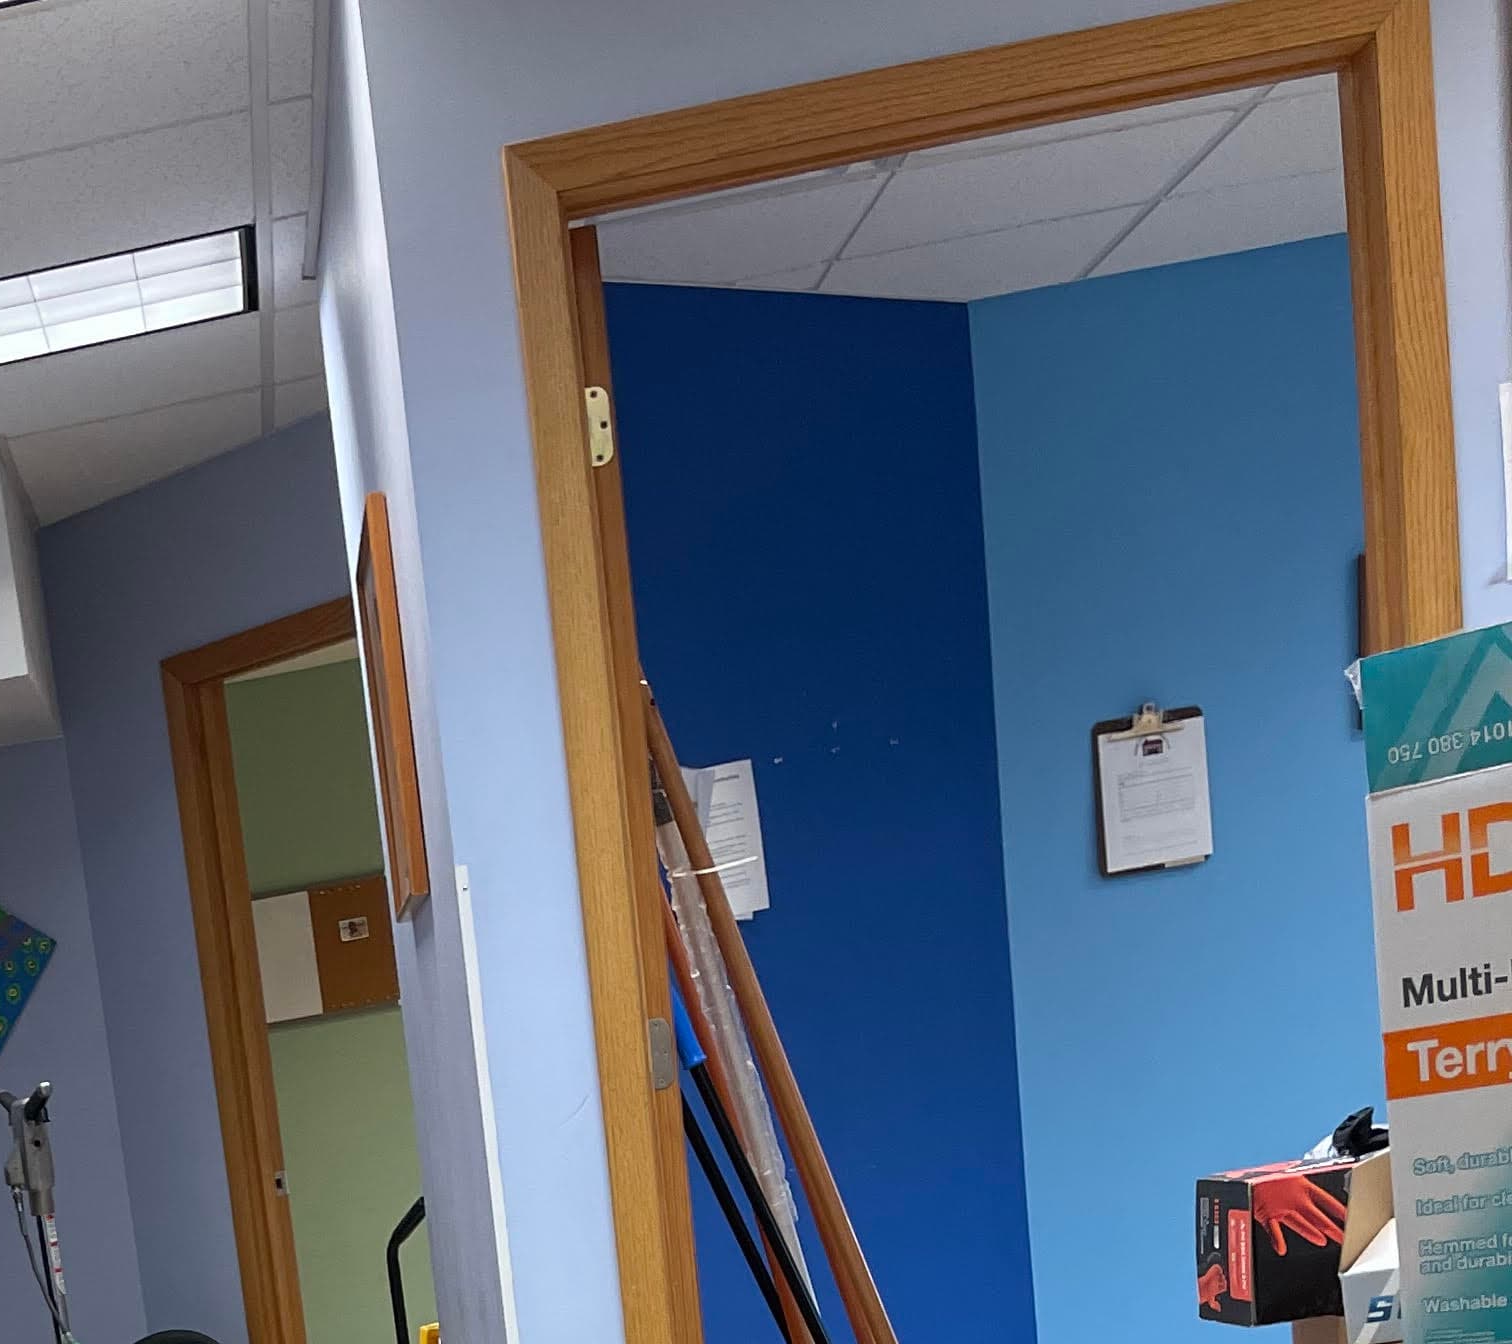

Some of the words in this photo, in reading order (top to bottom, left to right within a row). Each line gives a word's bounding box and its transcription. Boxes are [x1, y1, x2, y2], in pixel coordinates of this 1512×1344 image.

[1388, 741, 1422, 765] 750
[1427, 732, 1464, 756] 380
[1402, 959, 1512, 1008] Multi-
[1413, 1154, 1455, 1176] Soft,
[1416, 1195, 1458, 1216] Ideal
[1462, 1194, 1487, 1211] for
[1419, 1233, 1498, 1256] Hemmed
[1420, 1257, 1453, 1275] and
[1424, 1293, 1508, 1313] Washable
